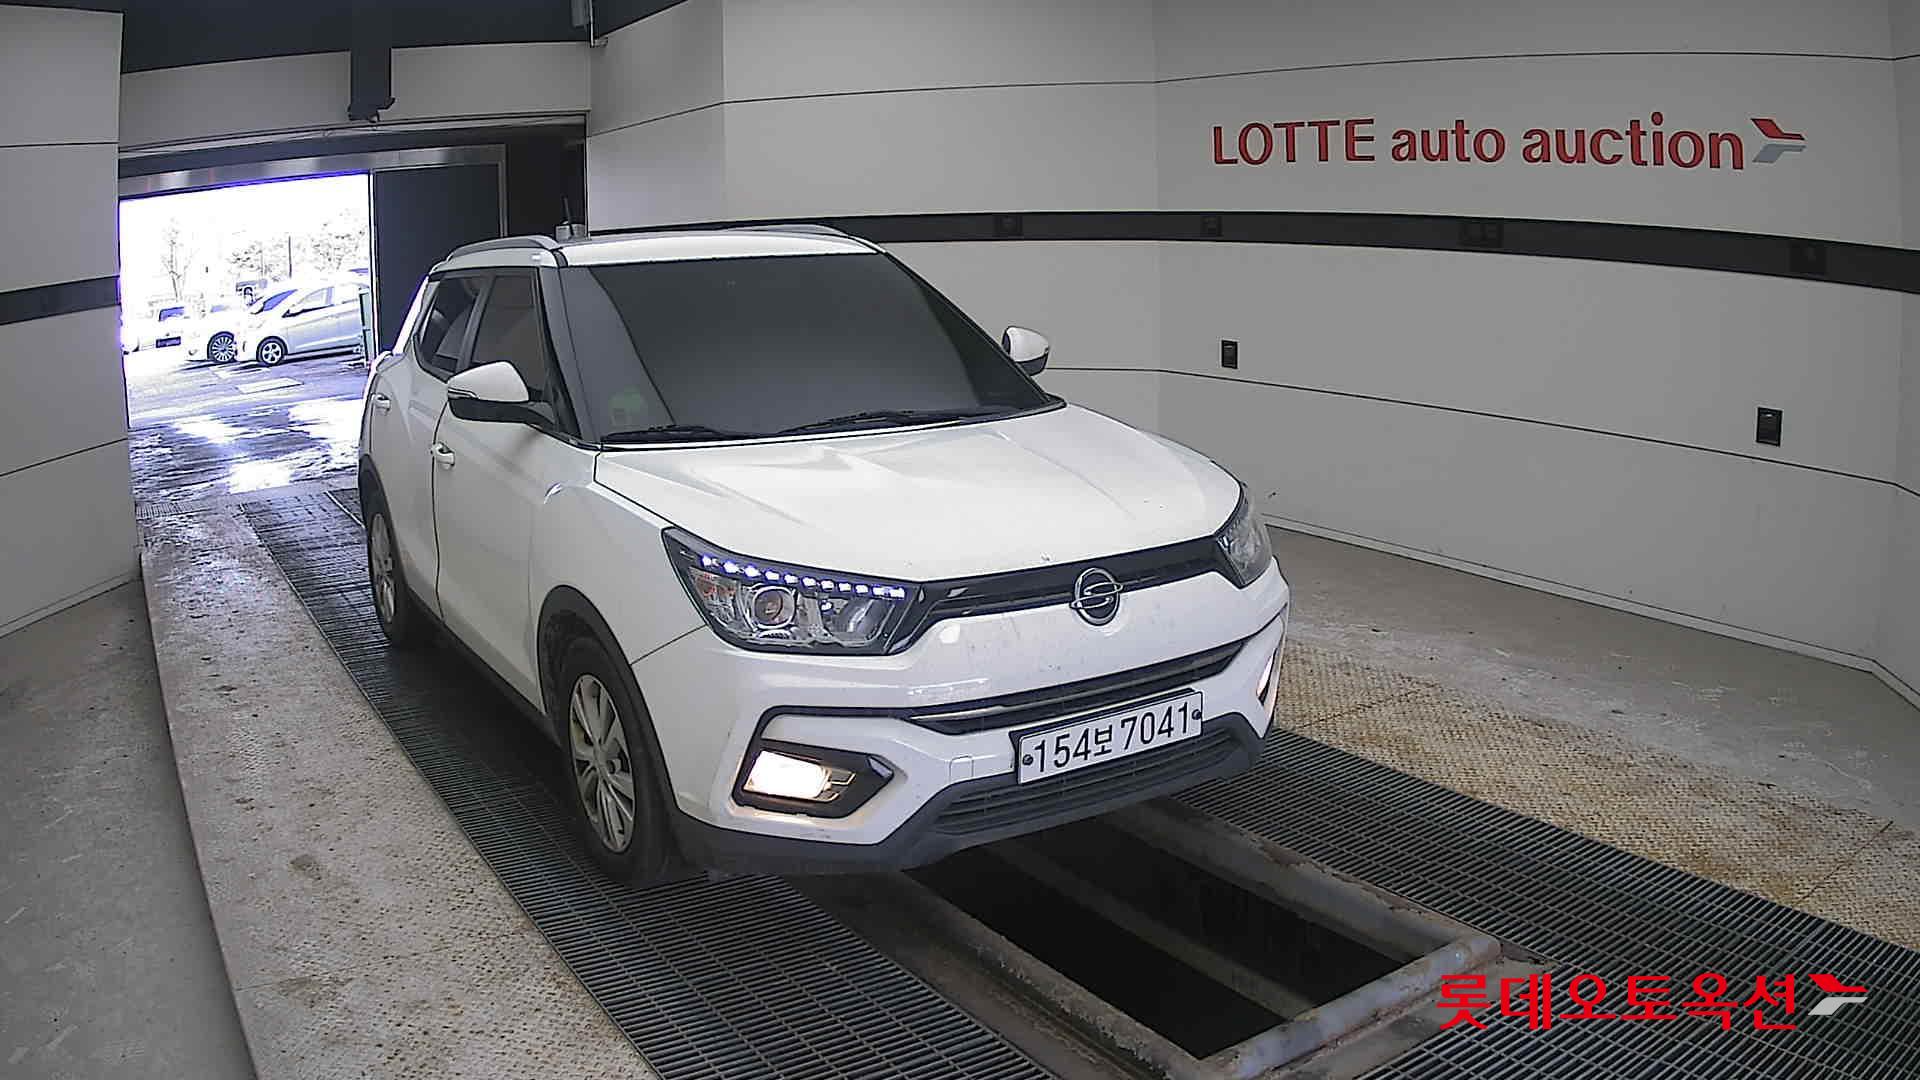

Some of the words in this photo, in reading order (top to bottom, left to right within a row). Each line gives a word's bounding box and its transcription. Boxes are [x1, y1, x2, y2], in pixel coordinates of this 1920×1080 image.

[1211, 118, 1376, 166] LOTTE
[1391, 119, 1505, 163] auto
[1521, 112, 1745, 171] auction
[1120, 701, 1189, 751] 7041
